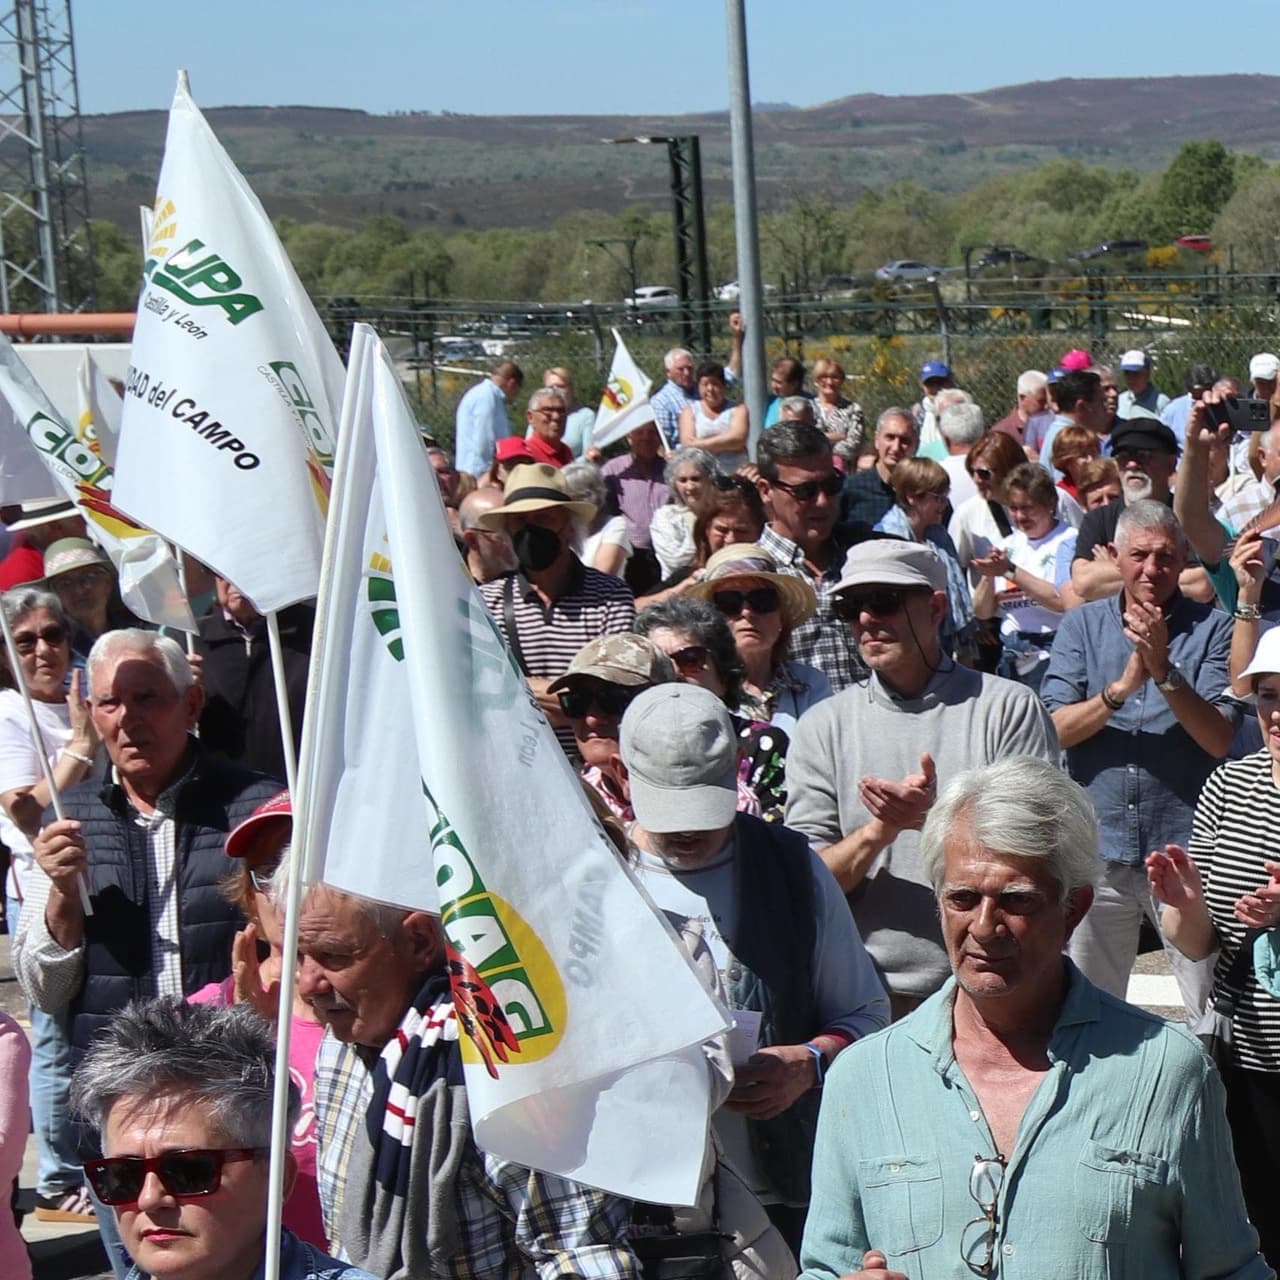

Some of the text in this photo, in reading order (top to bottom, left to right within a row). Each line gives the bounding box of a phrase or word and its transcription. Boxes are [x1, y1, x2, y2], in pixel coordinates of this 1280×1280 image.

[152, 238, 264, 326] UPA
[174, 312, 209, 340] León
[150, 380, 177, 411] del
[171, 398, 261, 471] CAMPO
